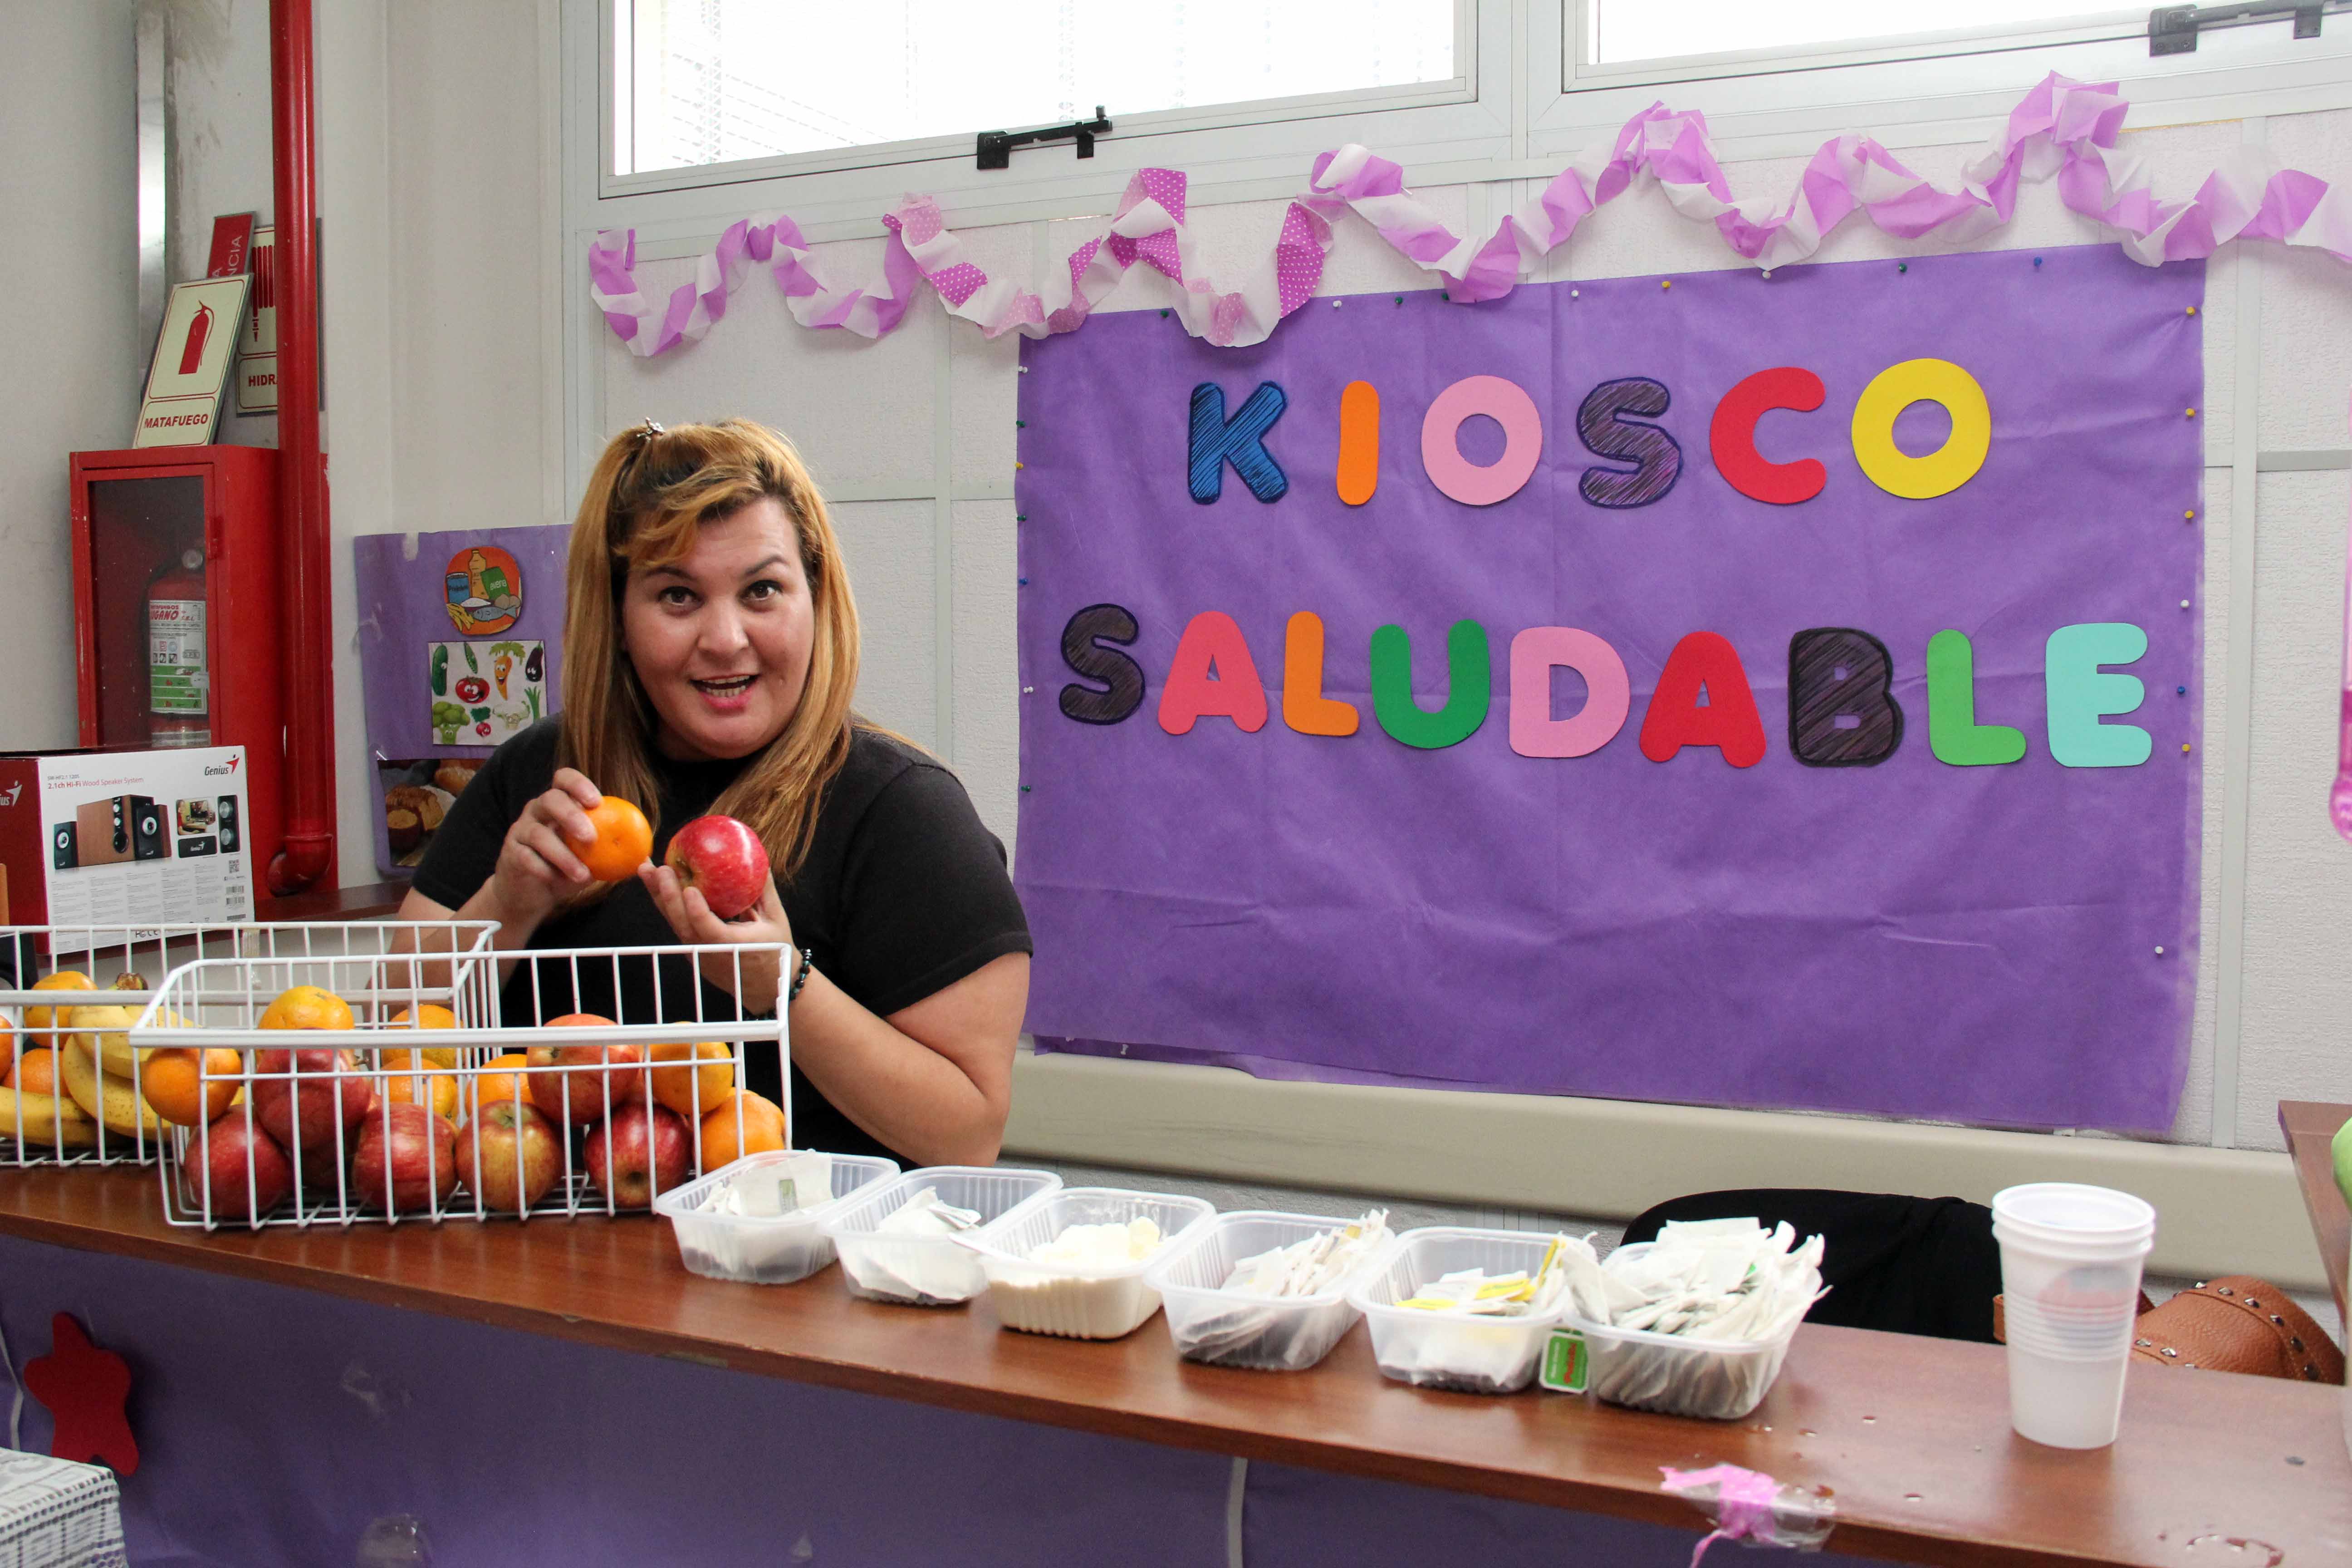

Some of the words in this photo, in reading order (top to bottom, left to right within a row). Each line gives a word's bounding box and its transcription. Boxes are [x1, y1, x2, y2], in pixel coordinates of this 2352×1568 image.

[248, 374, 277, 387] HIDR
[145, 413, 209, 429] MATAFUEGO
[1187, 358, 1992, 507] KIOSCO
[1058, 603, 2153, 769] SALUDABLE
[204, 765, 229, 776] Genius
